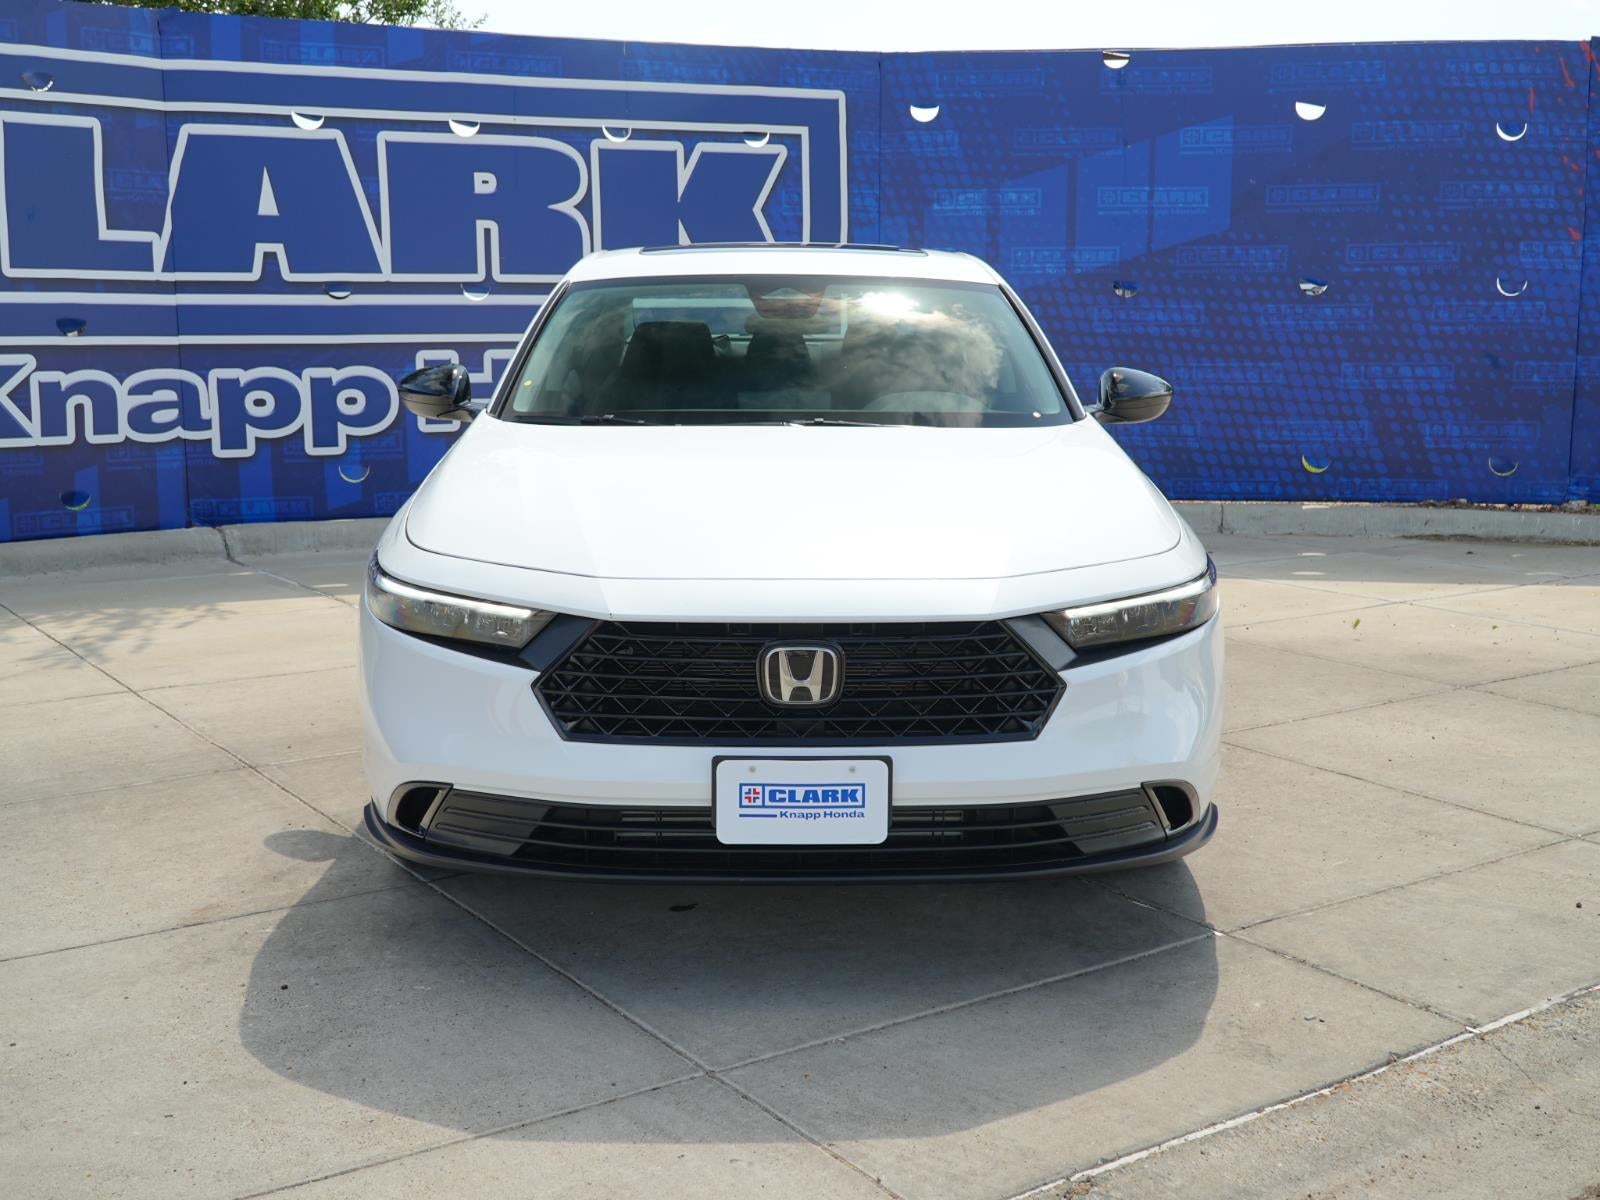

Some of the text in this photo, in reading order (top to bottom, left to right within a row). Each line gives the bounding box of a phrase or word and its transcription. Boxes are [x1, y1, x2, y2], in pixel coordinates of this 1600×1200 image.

[768, 789, 859, 803] CLARK
[779, 810, 865, 821] Knapp Honda
